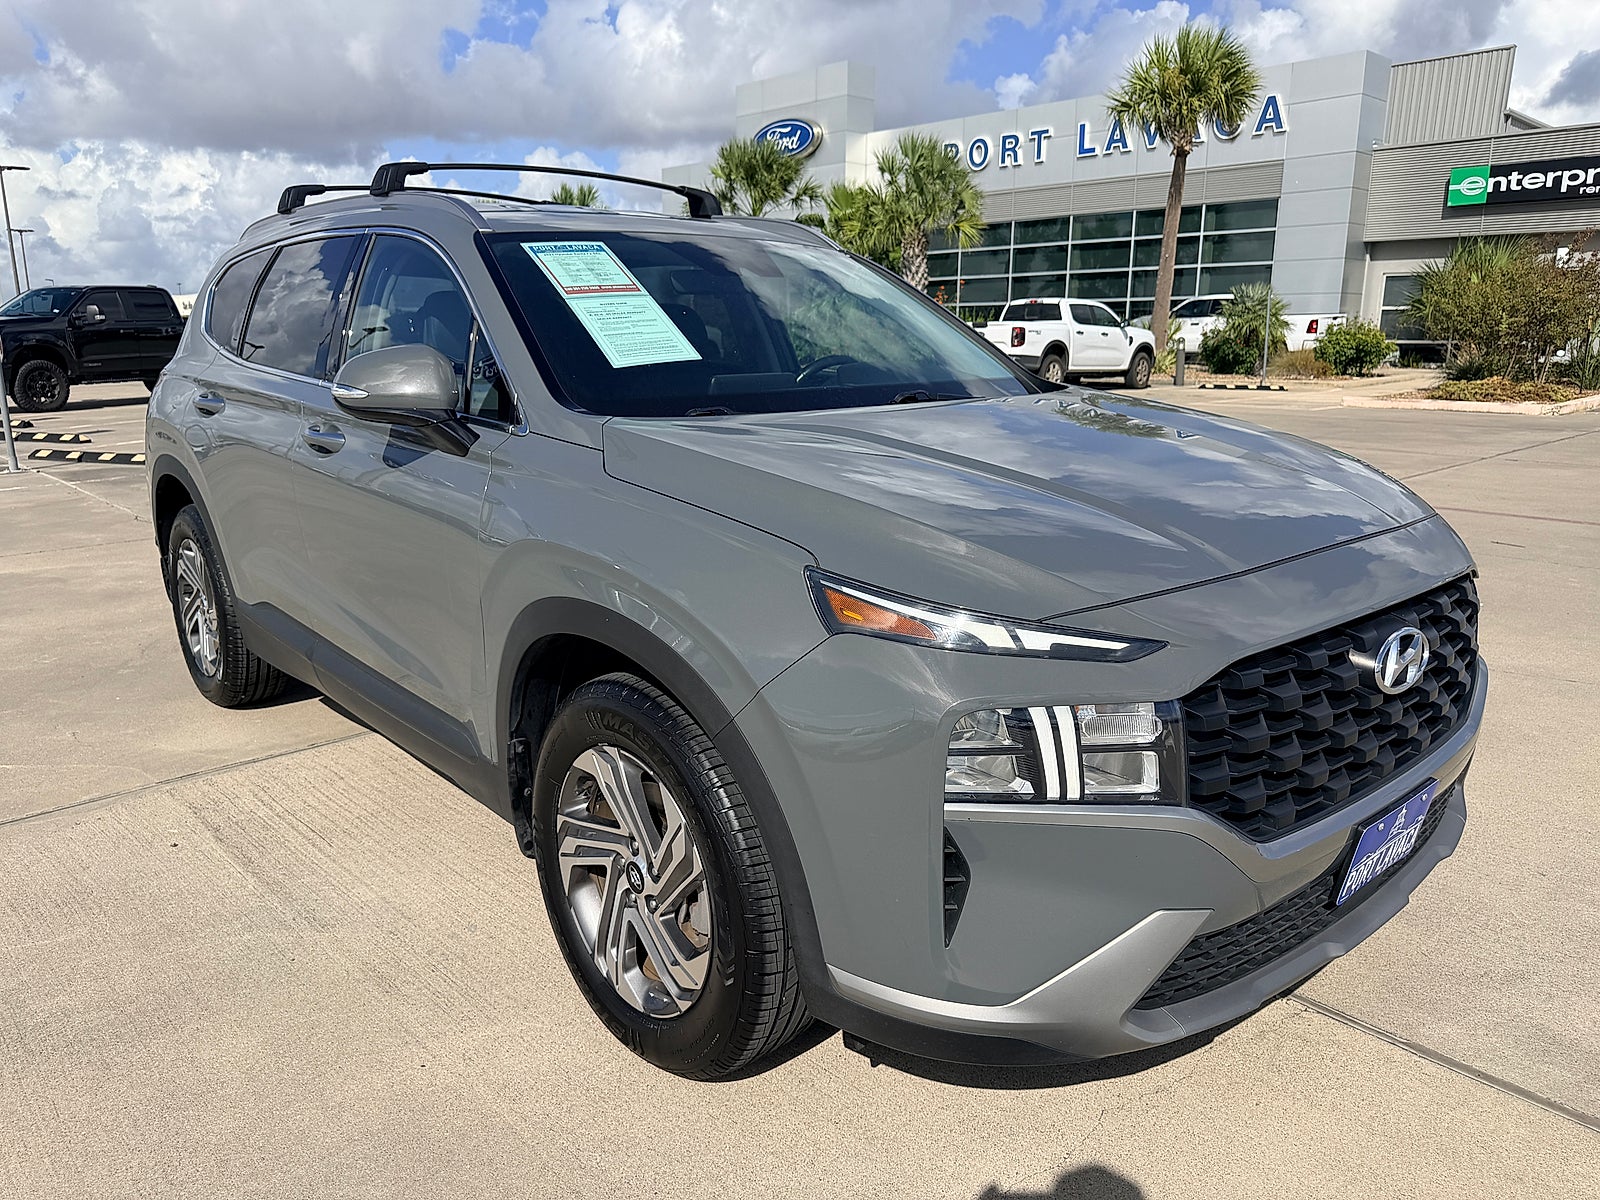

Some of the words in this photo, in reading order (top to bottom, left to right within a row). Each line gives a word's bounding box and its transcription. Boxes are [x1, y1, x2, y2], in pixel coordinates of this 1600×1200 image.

[766, 126, 801, 151] Ford
[942, 128, 1053, 171] PORT
[1077, 94, 1287, 158] LAVCA
[1341, 859, 1376, 897] PORT
